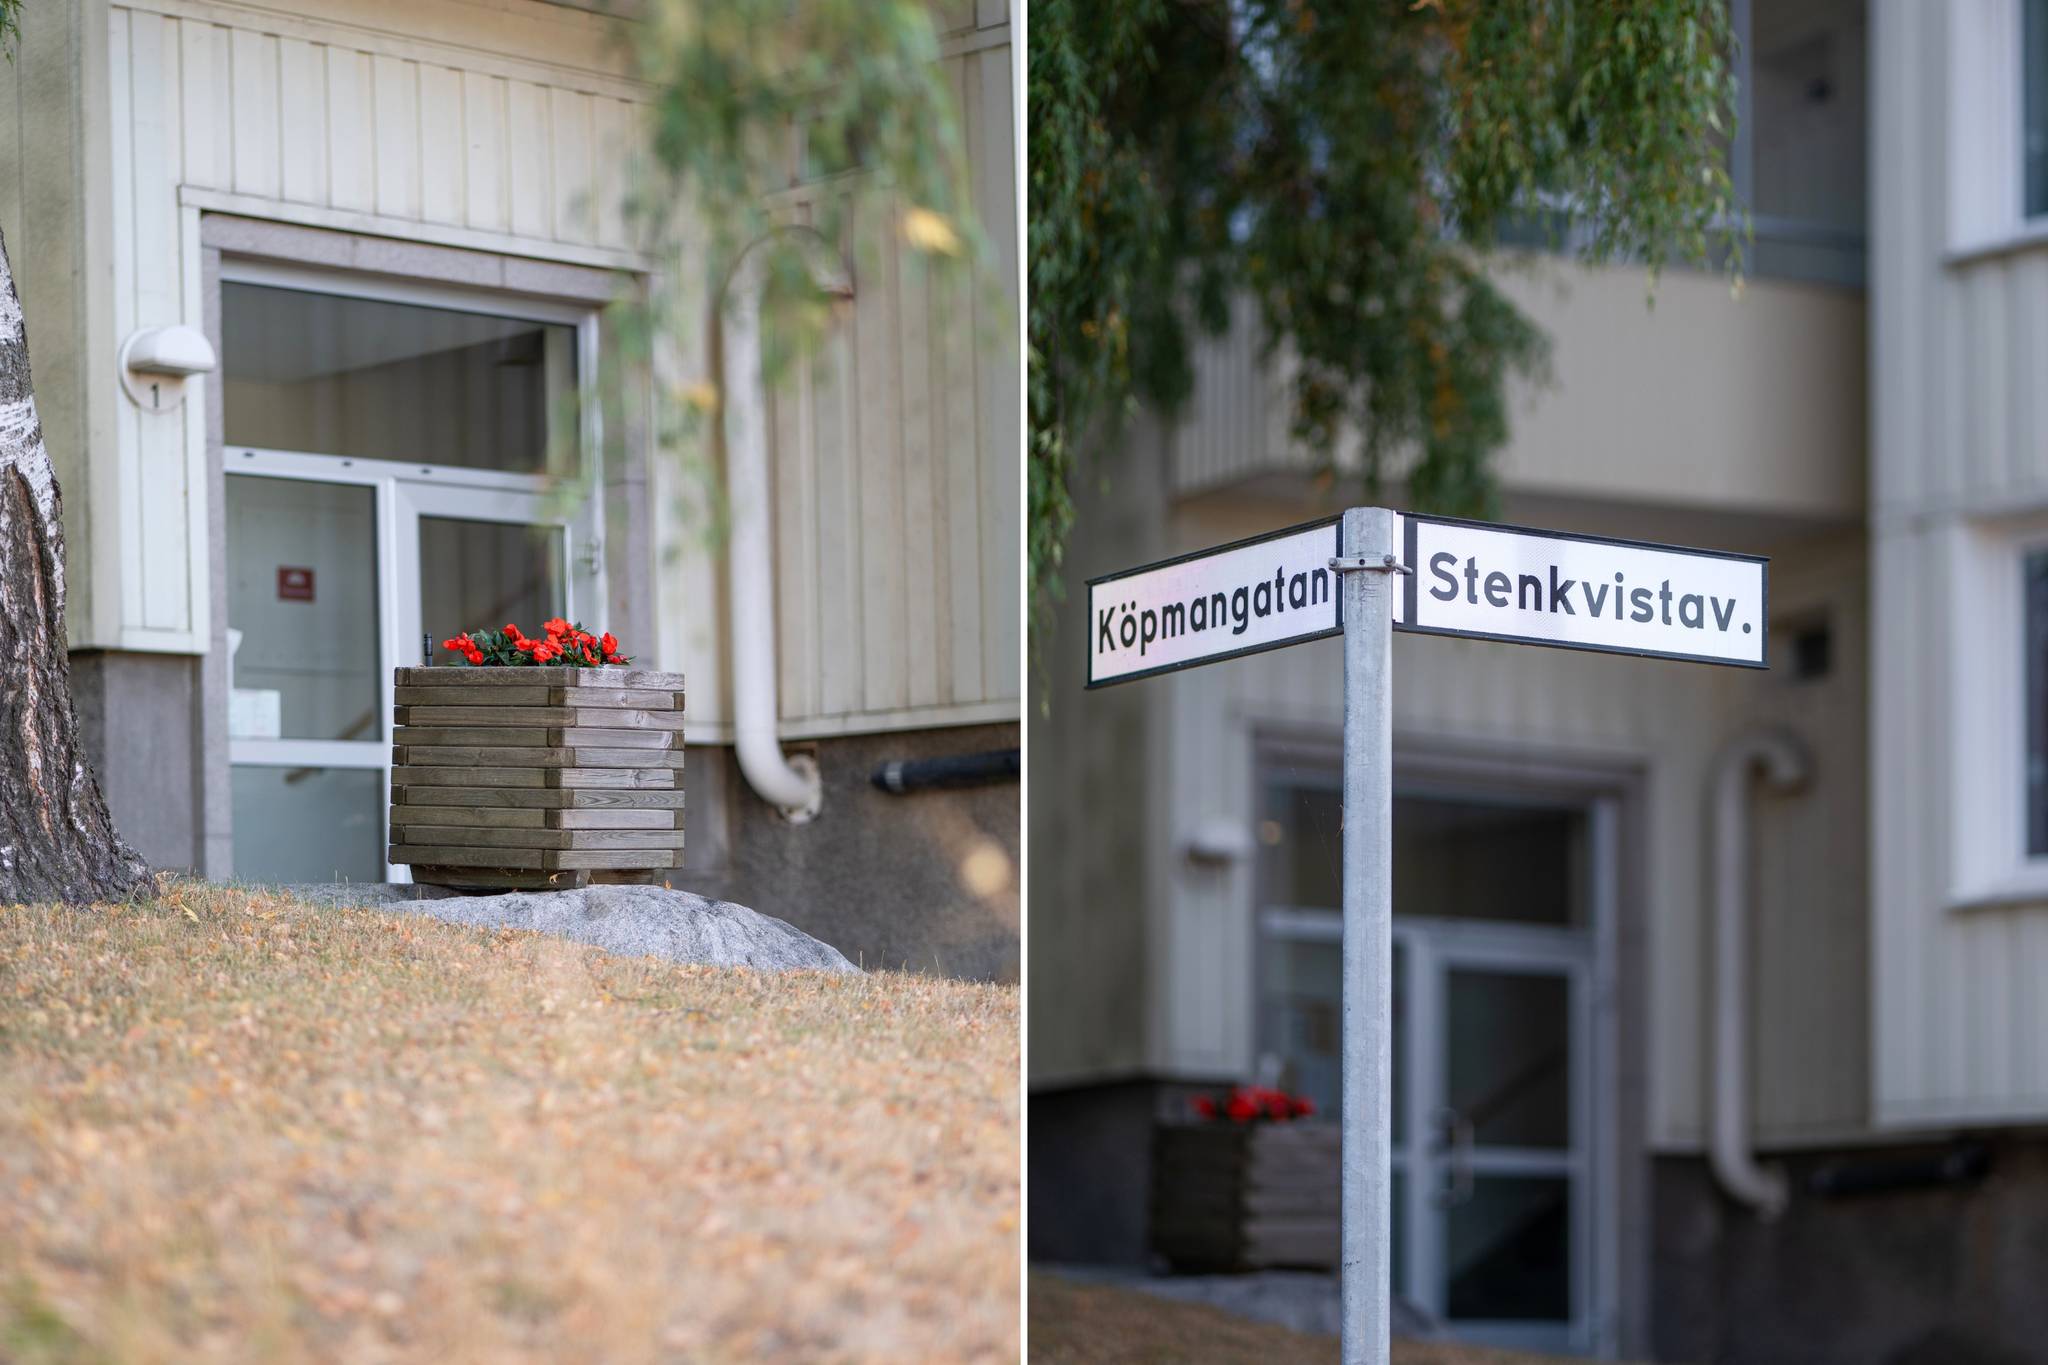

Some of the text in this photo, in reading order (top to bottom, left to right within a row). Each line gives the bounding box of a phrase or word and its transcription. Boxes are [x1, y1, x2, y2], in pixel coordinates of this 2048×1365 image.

[151, 383, 159, 408] 1
[1099, 566, 1328, 656] Köpmangatan
[1429, 552, 1751, 634] Stenkvistav.
